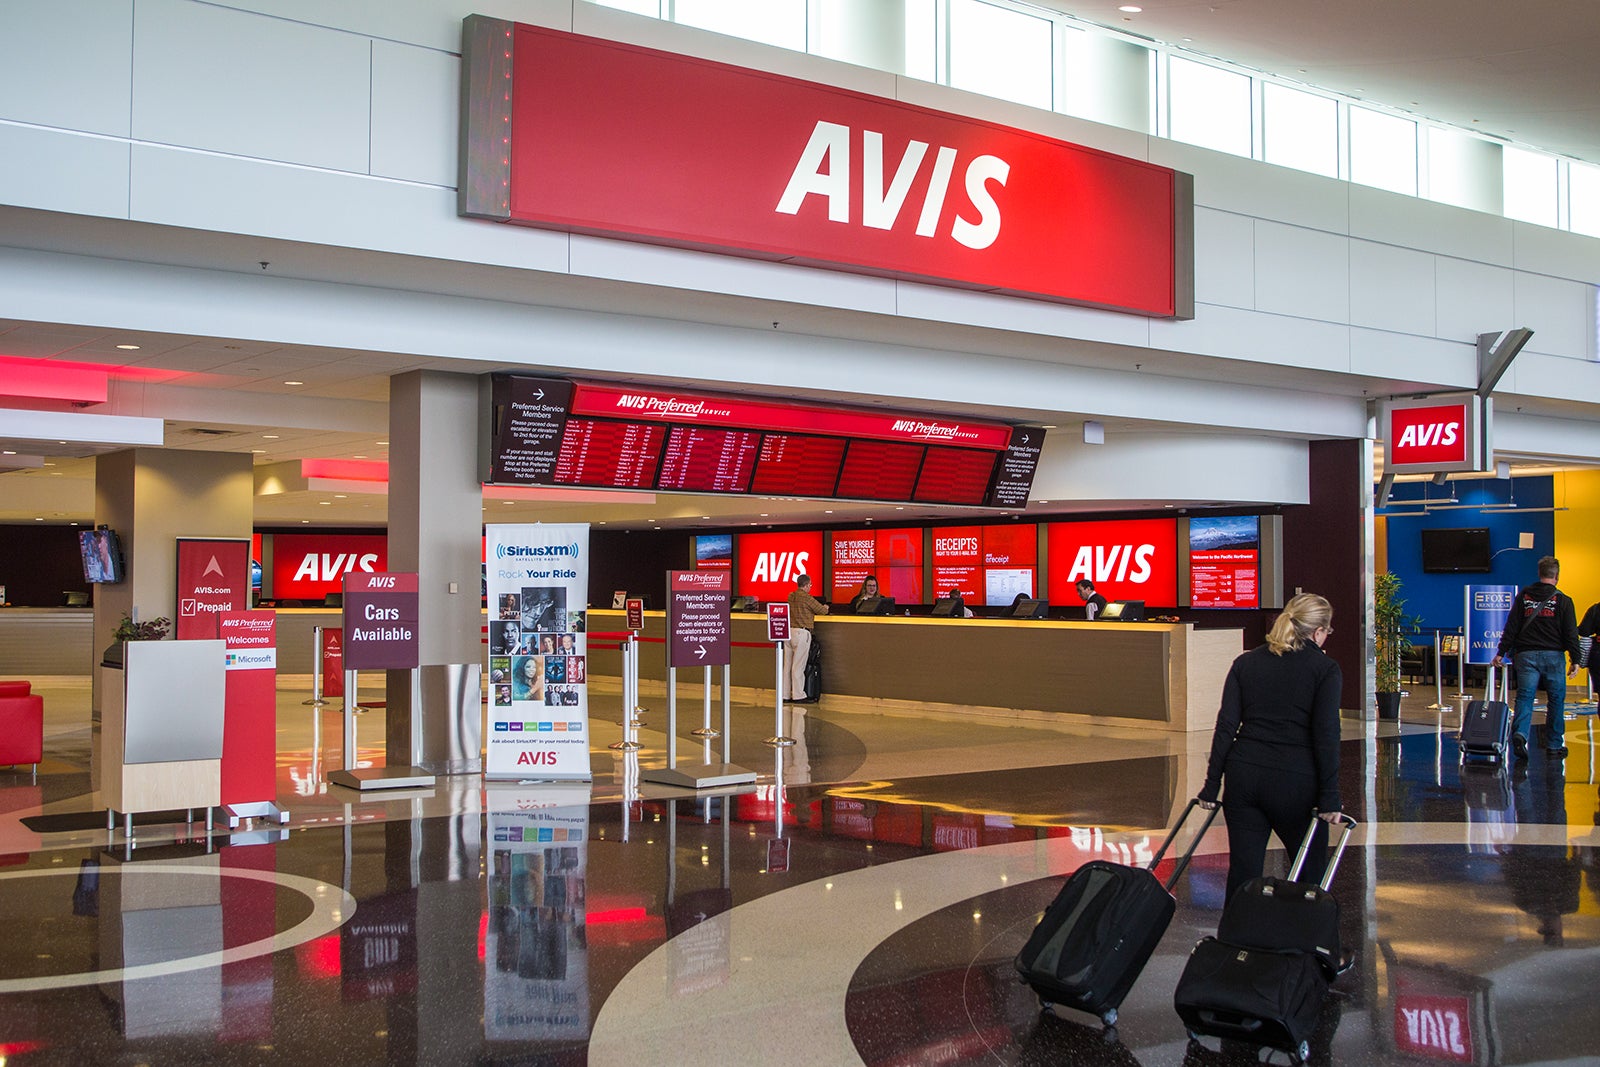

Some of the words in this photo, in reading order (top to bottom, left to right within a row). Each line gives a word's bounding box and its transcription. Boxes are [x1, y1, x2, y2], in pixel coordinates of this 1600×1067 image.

[775, 120, 1010, 250] AVIS
[512, 402, 540, 411] Preferred
[542, 405, 564, 413] Service
[616, 395, 647, 409] AVIS
[646, 398, 704, 417] Preferred
[700, 408, 731, 416] SERVICE
[522, 411, 551, 419] Members
[891, 420, 916, 432] AVIS
[914, 422, 959, 439] Preferred
[1398, 422, 1459, 448] AVIS
[835, 541, 848, 549] SAVE
[848, 540, 875, 548] YOURSELF
[936, 538, 978, 550] RECEIPTS
[835, 549, 848, 559] THE
[849, 549, 875, 558] HASSLE
[293, 553, 378, 581] AVIS
[751, 551, 809, 583] AVIS
[1067, 544, 1155, 584] AVIS
[498, 570, 523, 578] Rock
[526, 570, 550, 578] Your
[553, 570, 576, 578] Ride
[678, 574, 694, 582] AVIS
[693, 574, 723, 584] Preferred
[368, 577, 396, 588] AVIS
[675, 594, 703, 602] Preferred
[704, 594, 725, 602] Service
[1484, 594, 1504, 602] FOX
[197, 602, 232, 613] Prepaid
[364, 604, 399, 620] Cars
[239, 618, 274, 628] Preferred
[699, 613, 720, 622] proceed
[352, 628, 412, 640] Available
[227, 636, 269, 644] Welcomes
[238, 654, 271, 663] Microsoft
[517, 752, 557, 765] AVIS
